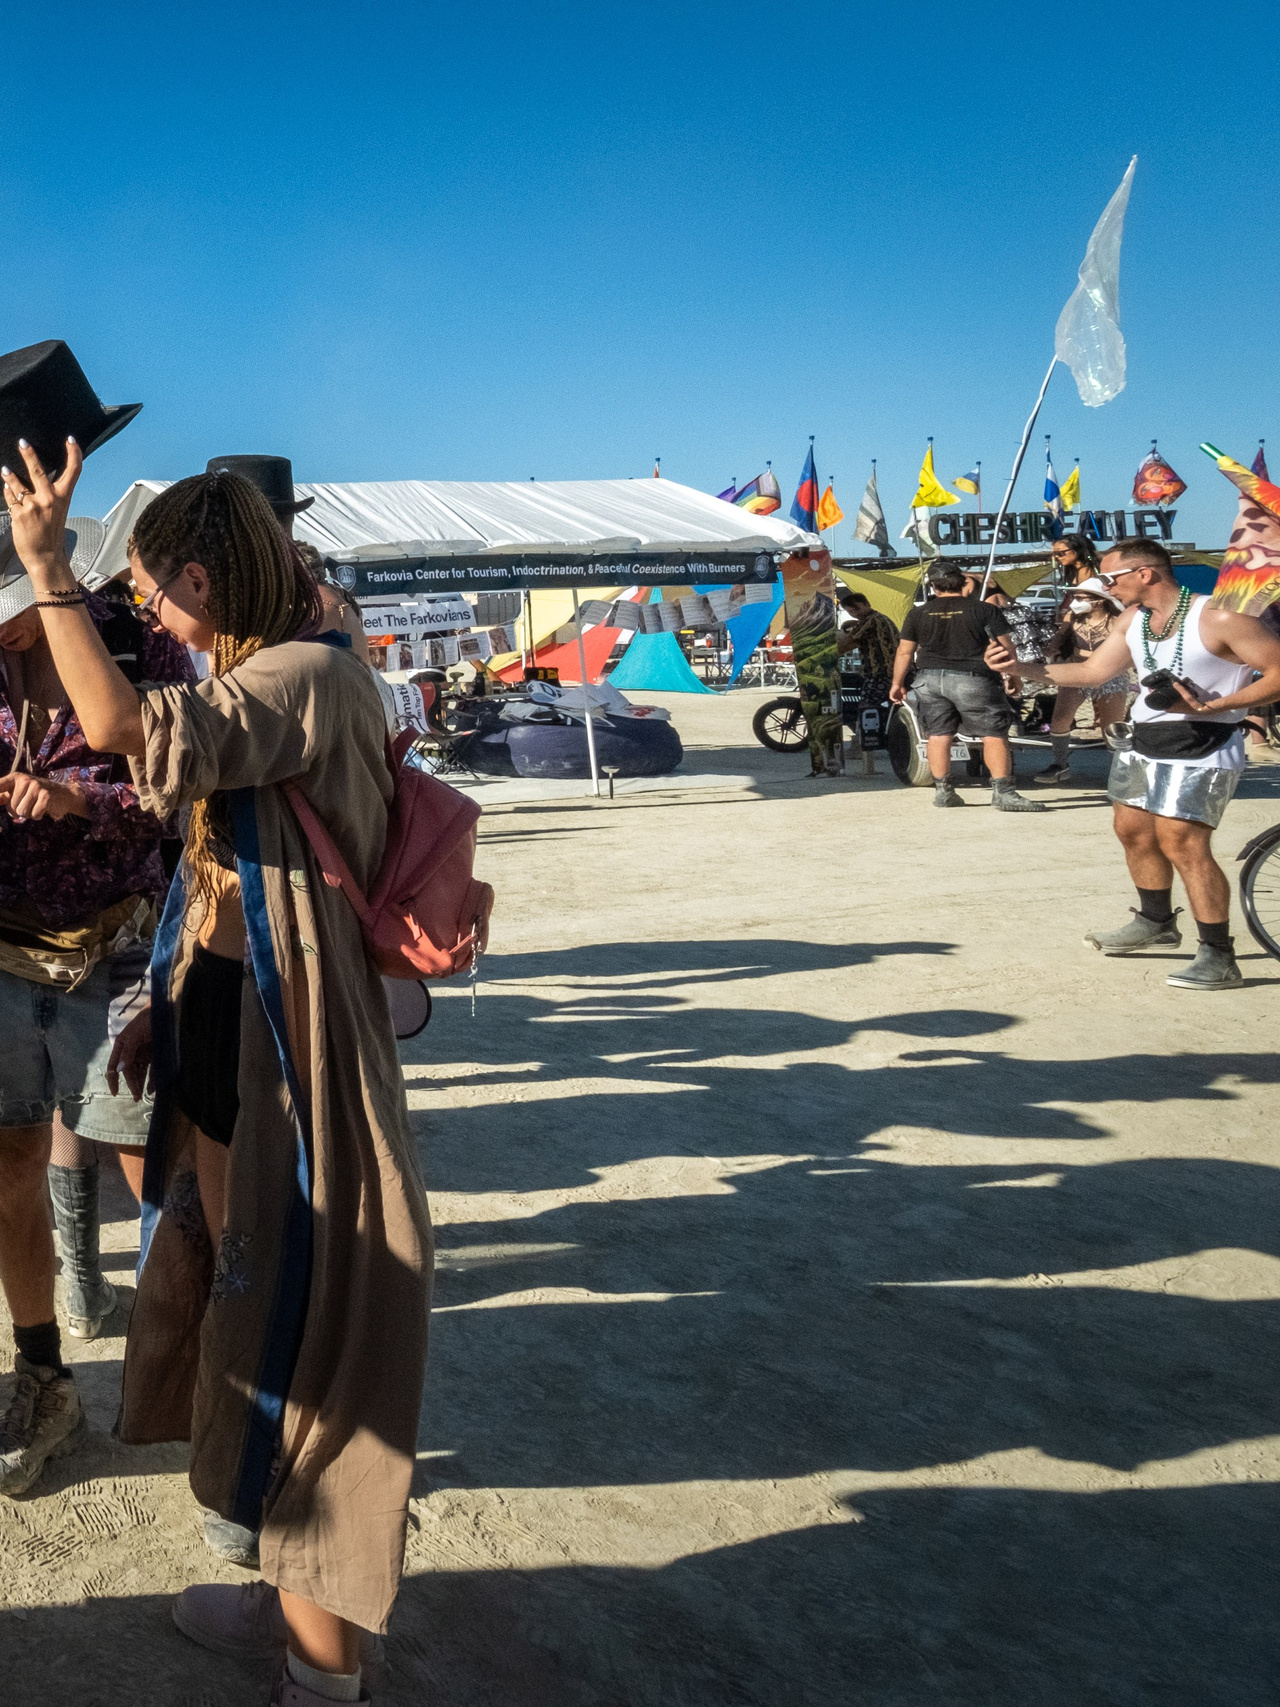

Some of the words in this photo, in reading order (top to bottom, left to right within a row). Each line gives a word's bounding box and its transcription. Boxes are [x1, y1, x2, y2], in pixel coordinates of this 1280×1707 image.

[415, 568, 450, 580] Center
[451, 567, 465, 579] for
[467, 566, 511, 578] Tourism,
[512, 564, 587, 576] Indoctrination,
[588, 564, 594, 574] &
[594, 563, 631, 574] Peaceful
[631, 563, 686, 574] Coexistence
[686, 563, 708, 573] With
[708, 563, 746, 573] Burners
[361, 616, 382, 628] eet
[384, 614, 408, 626] The
[409, 609, 471, 626] Farkovians
